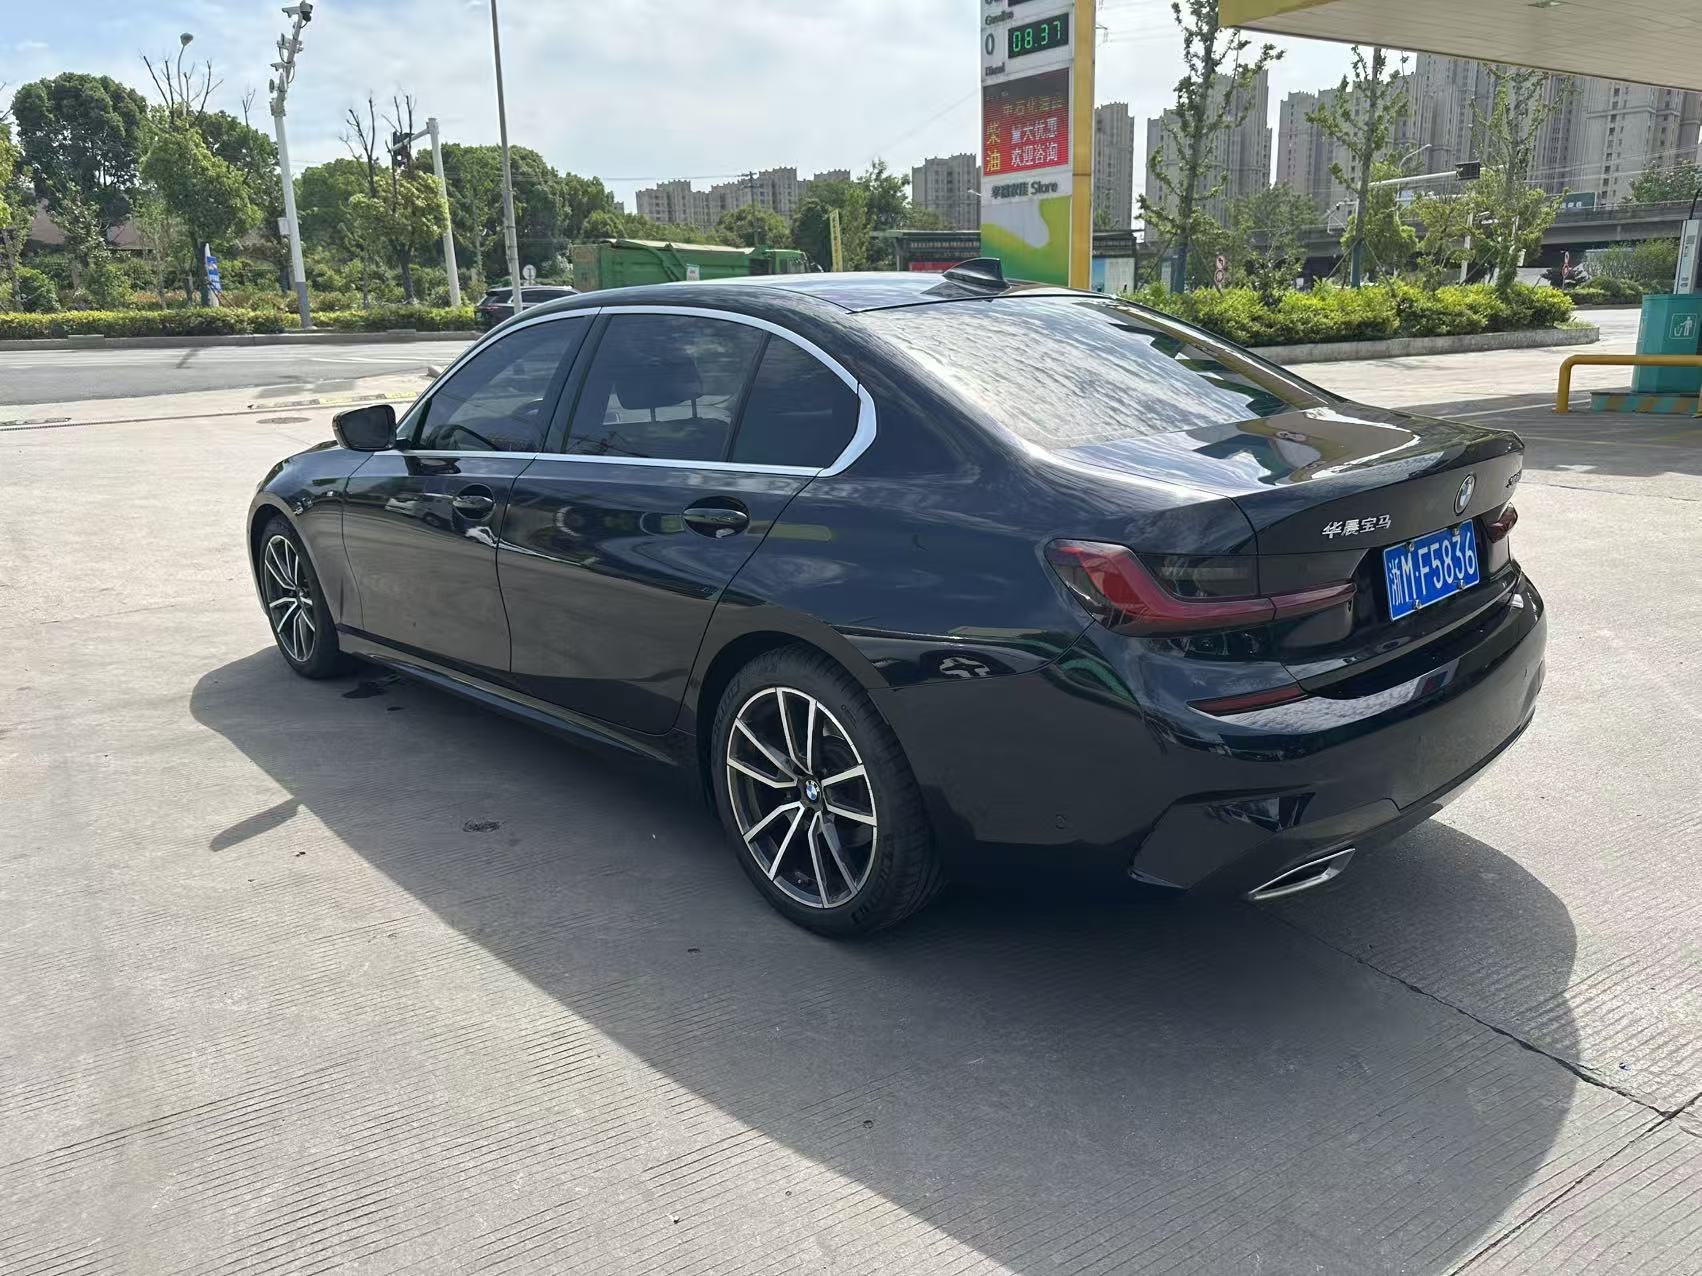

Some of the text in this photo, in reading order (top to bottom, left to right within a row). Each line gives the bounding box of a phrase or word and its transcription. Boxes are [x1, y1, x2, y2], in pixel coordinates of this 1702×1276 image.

[984, 33, 995, 55] 0
[1012, 20, 1061, 52] 08.37
[1011, 117, 1057, 144] 重大优惠
[987, 119, 1000, 172] 柴油
[1011, 142, 1057, 167] 欢迎咨询
[1030, 180, 1058, 196] Store
[1322, 514, 1392, 539] 华晨宝马
